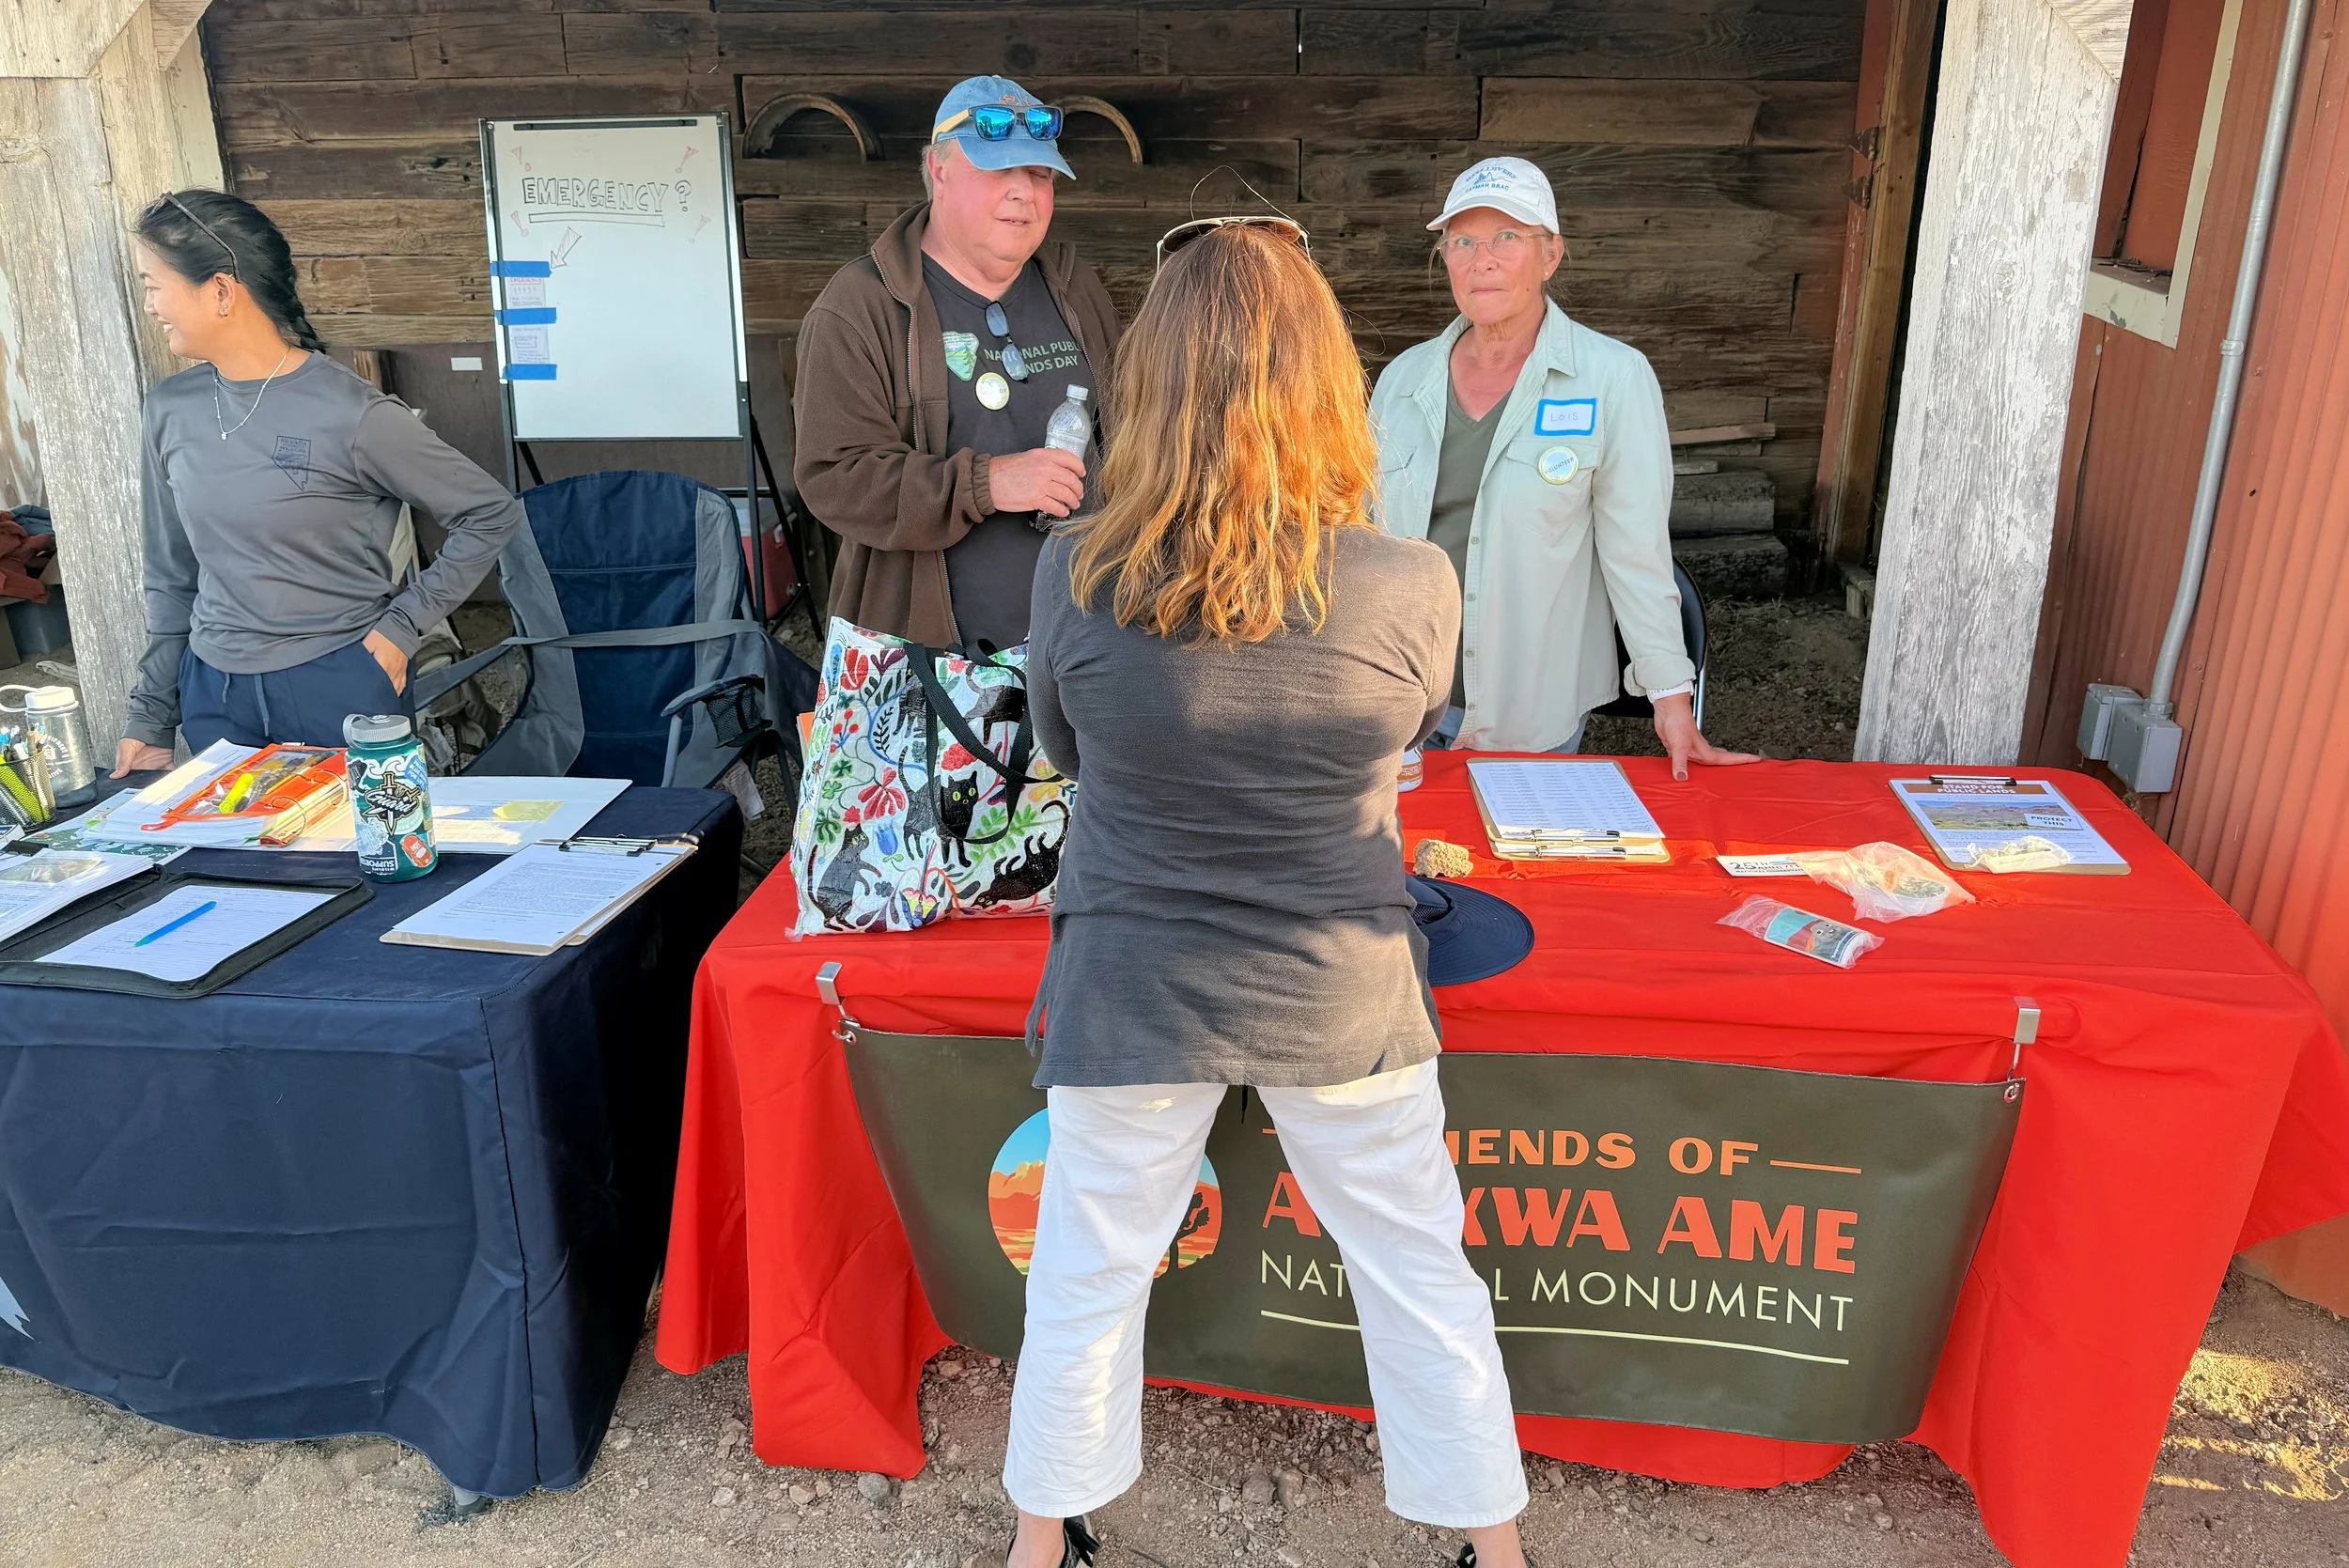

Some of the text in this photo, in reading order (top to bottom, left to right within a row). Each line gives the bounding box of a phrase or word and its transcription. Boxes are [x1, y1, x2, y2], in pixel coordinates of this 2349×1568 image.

[521, 177, 669, 213] EMERGENCY
[1050, 340, 1081, 353] PUBL
[1054, 355, 1078, 368] DAY
[1544, 457, 1575, 474] VOLUNTEER
[1445, 1129, 1759, 1176] IENDS OF
[1657, 1195, 1859, 1274] AME
[1531, 1267, 1854, 1332] MONUMENT
